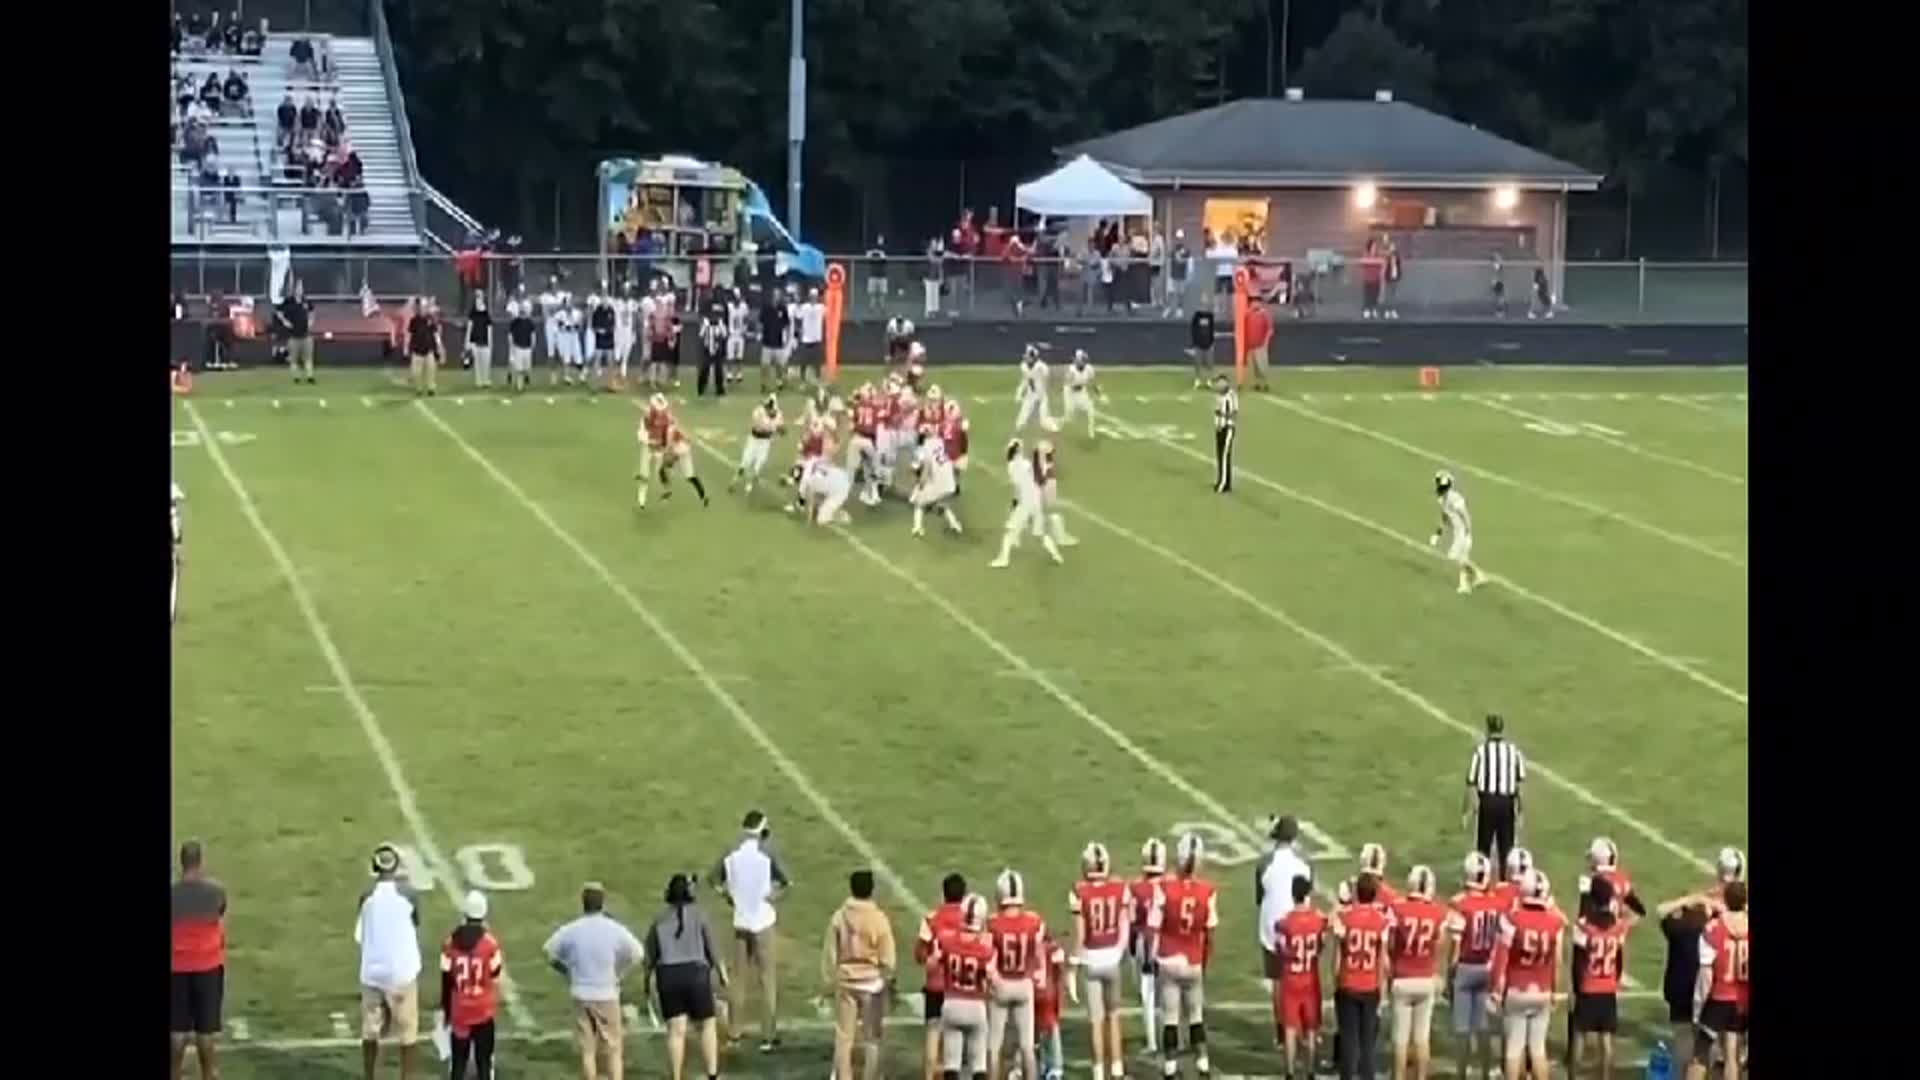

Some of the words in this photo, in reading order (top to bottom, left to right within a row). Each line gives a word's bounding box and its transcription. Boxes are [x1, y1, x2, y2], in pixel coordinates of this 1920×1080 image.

[1090, 895, 1117, 937] 81
[1180, 896, 1196, 935] 5
[1403, 916, 1435, 956] 72
